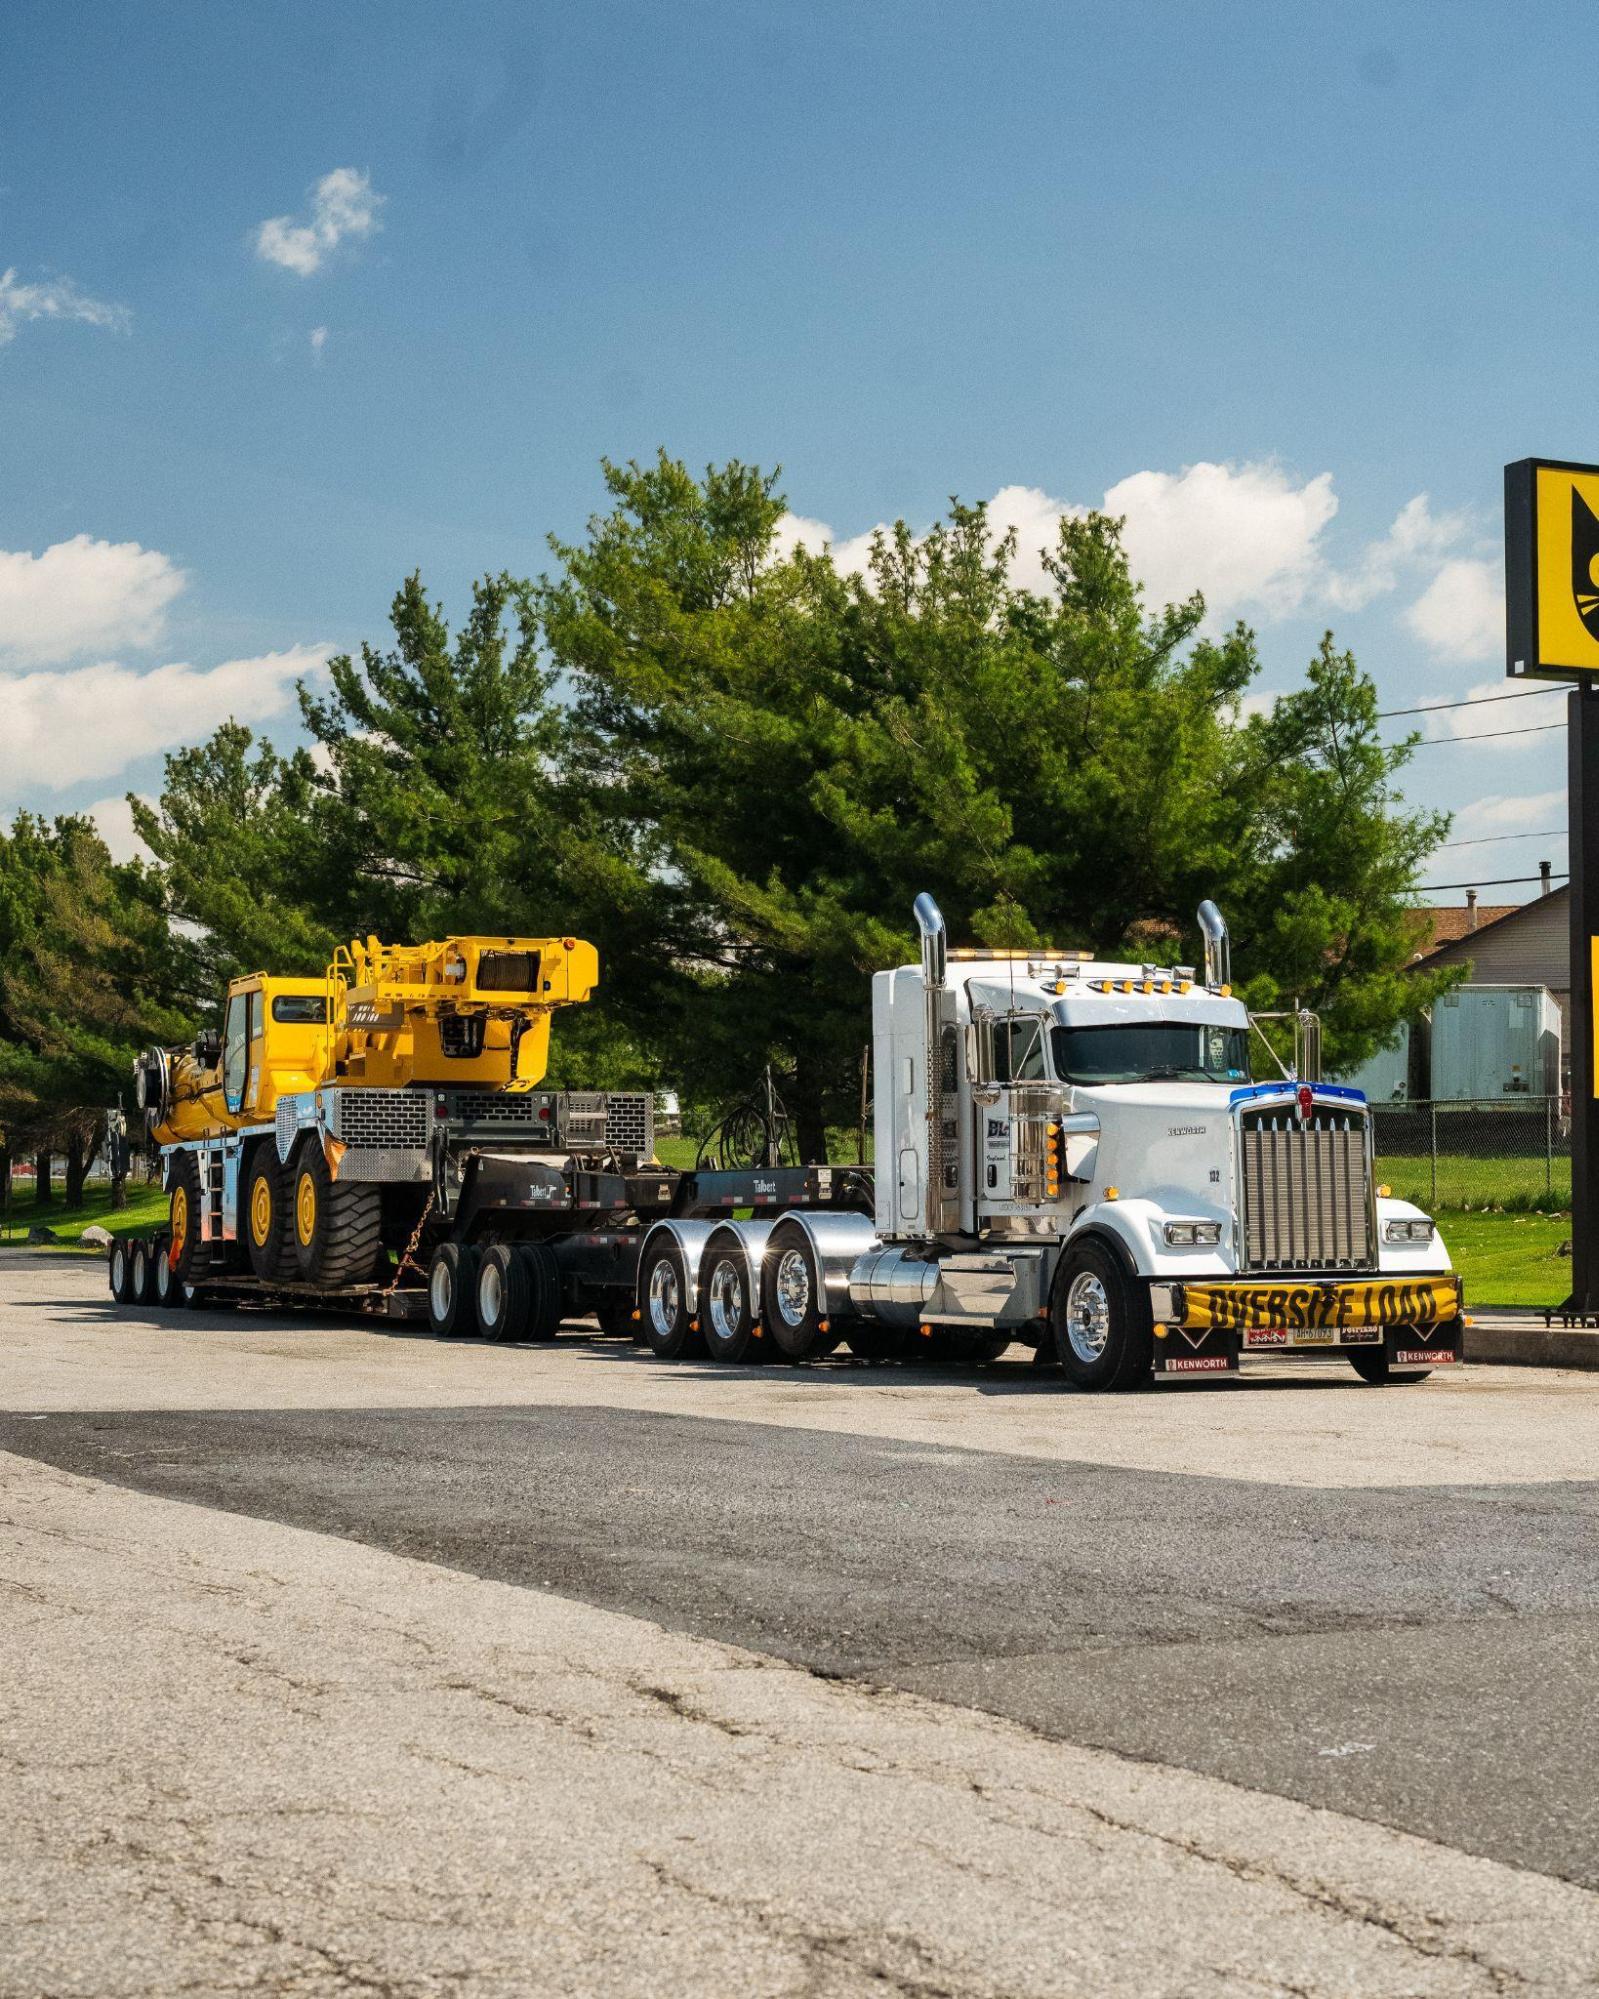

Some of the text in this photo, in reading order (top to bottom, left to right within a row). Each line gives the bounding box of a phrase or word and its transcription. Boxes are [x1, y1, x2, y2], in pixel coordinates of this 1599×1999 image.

[753, 1180, 776, 1193] Talbert
[1207, 1284, 1437, 1329] OVERSIZE LOAD
[1407, 1351, 1454, 1361] KENWORTH
[1177, 1359, 1227, 1369] KENWORTH
